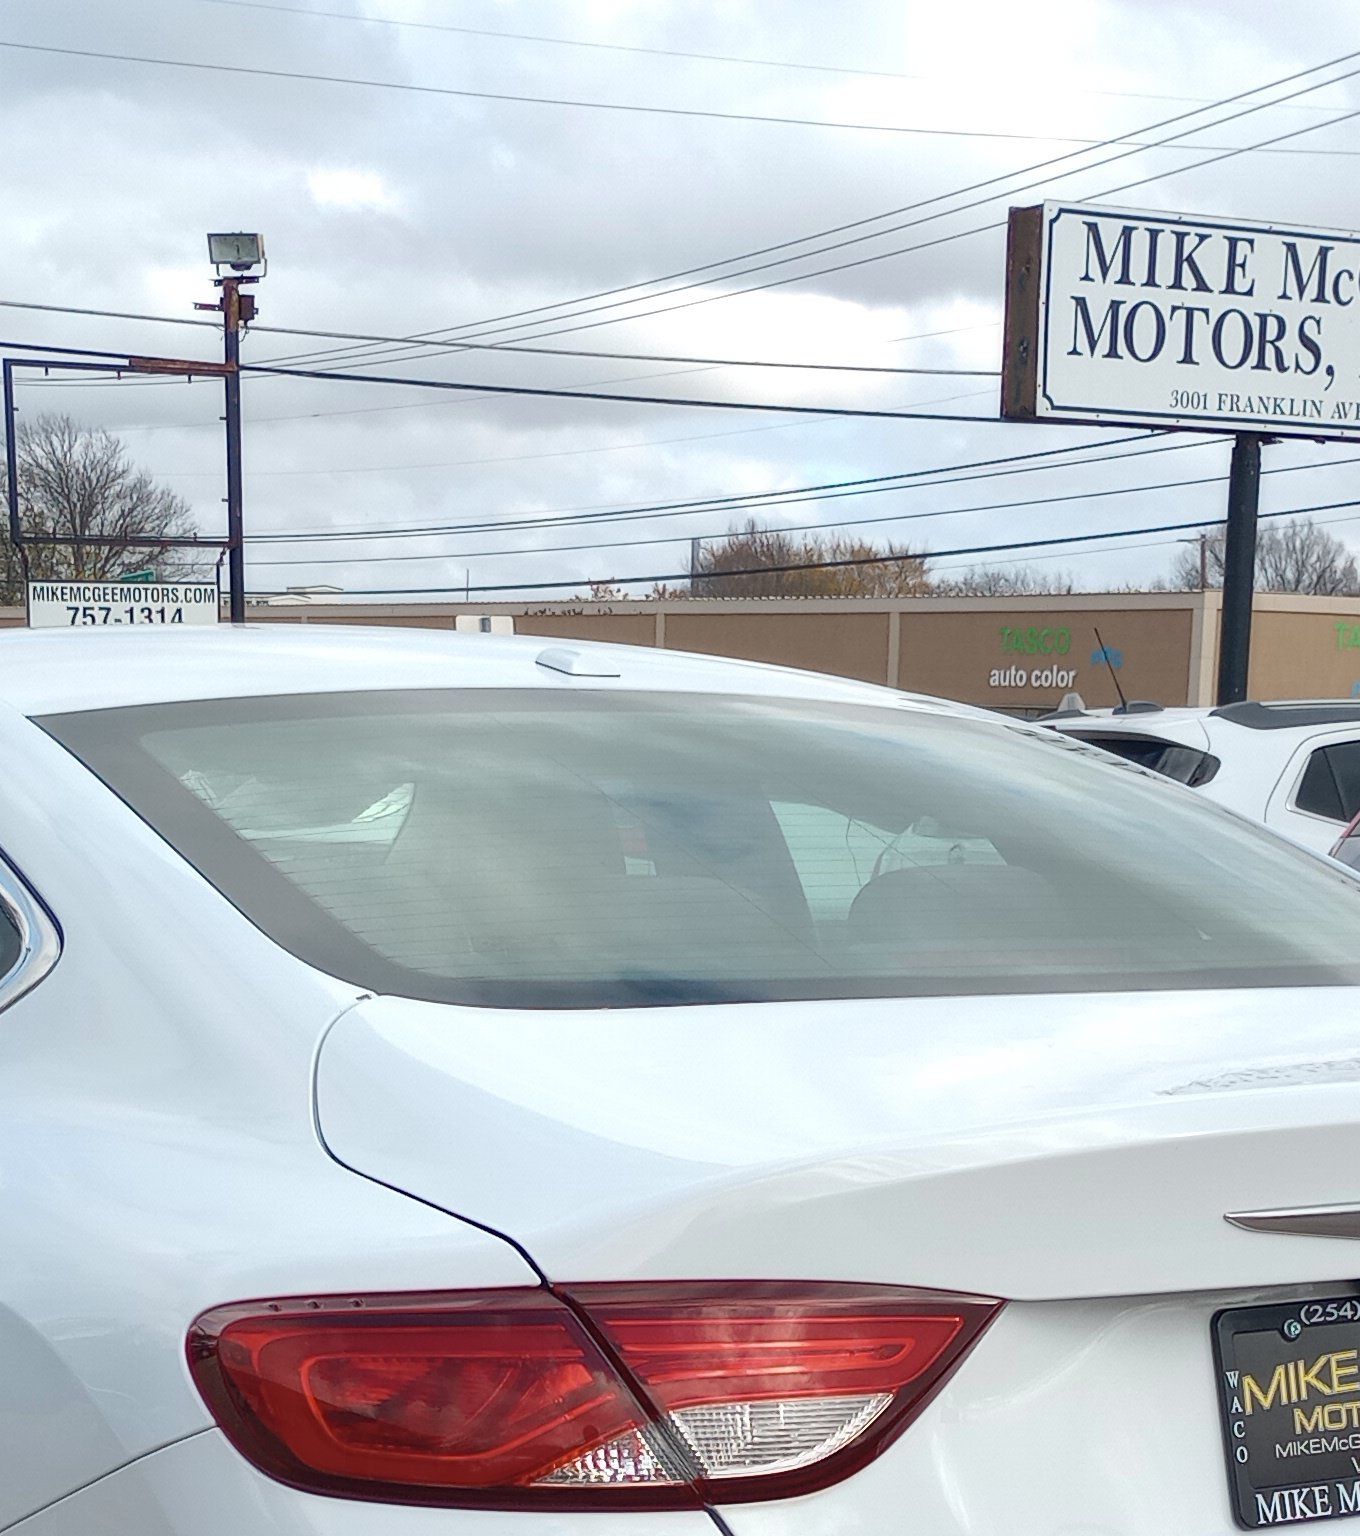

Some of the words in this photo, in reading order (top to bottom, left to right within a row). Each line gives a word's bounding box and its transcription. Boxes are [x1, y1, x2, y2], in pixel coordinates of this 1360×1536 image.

[1080, 221, 1256, 298] MIKE
[1067, 296, 1336, 391] MOTORS,
[1170, 389, 1210, 412] 3001
[1216, 393, 1325, 419] FRANKLIN
[66, 606, 184, 626] 757-1314
[999, 625, 1072, 655] TASCO
[989, 664, 1028, 688] auto
[1030, 663, 1077, 689] color
[1242, 1350, 1360, 1416] MIKE
[1255, 1486, 1333, 1525] MIKE
